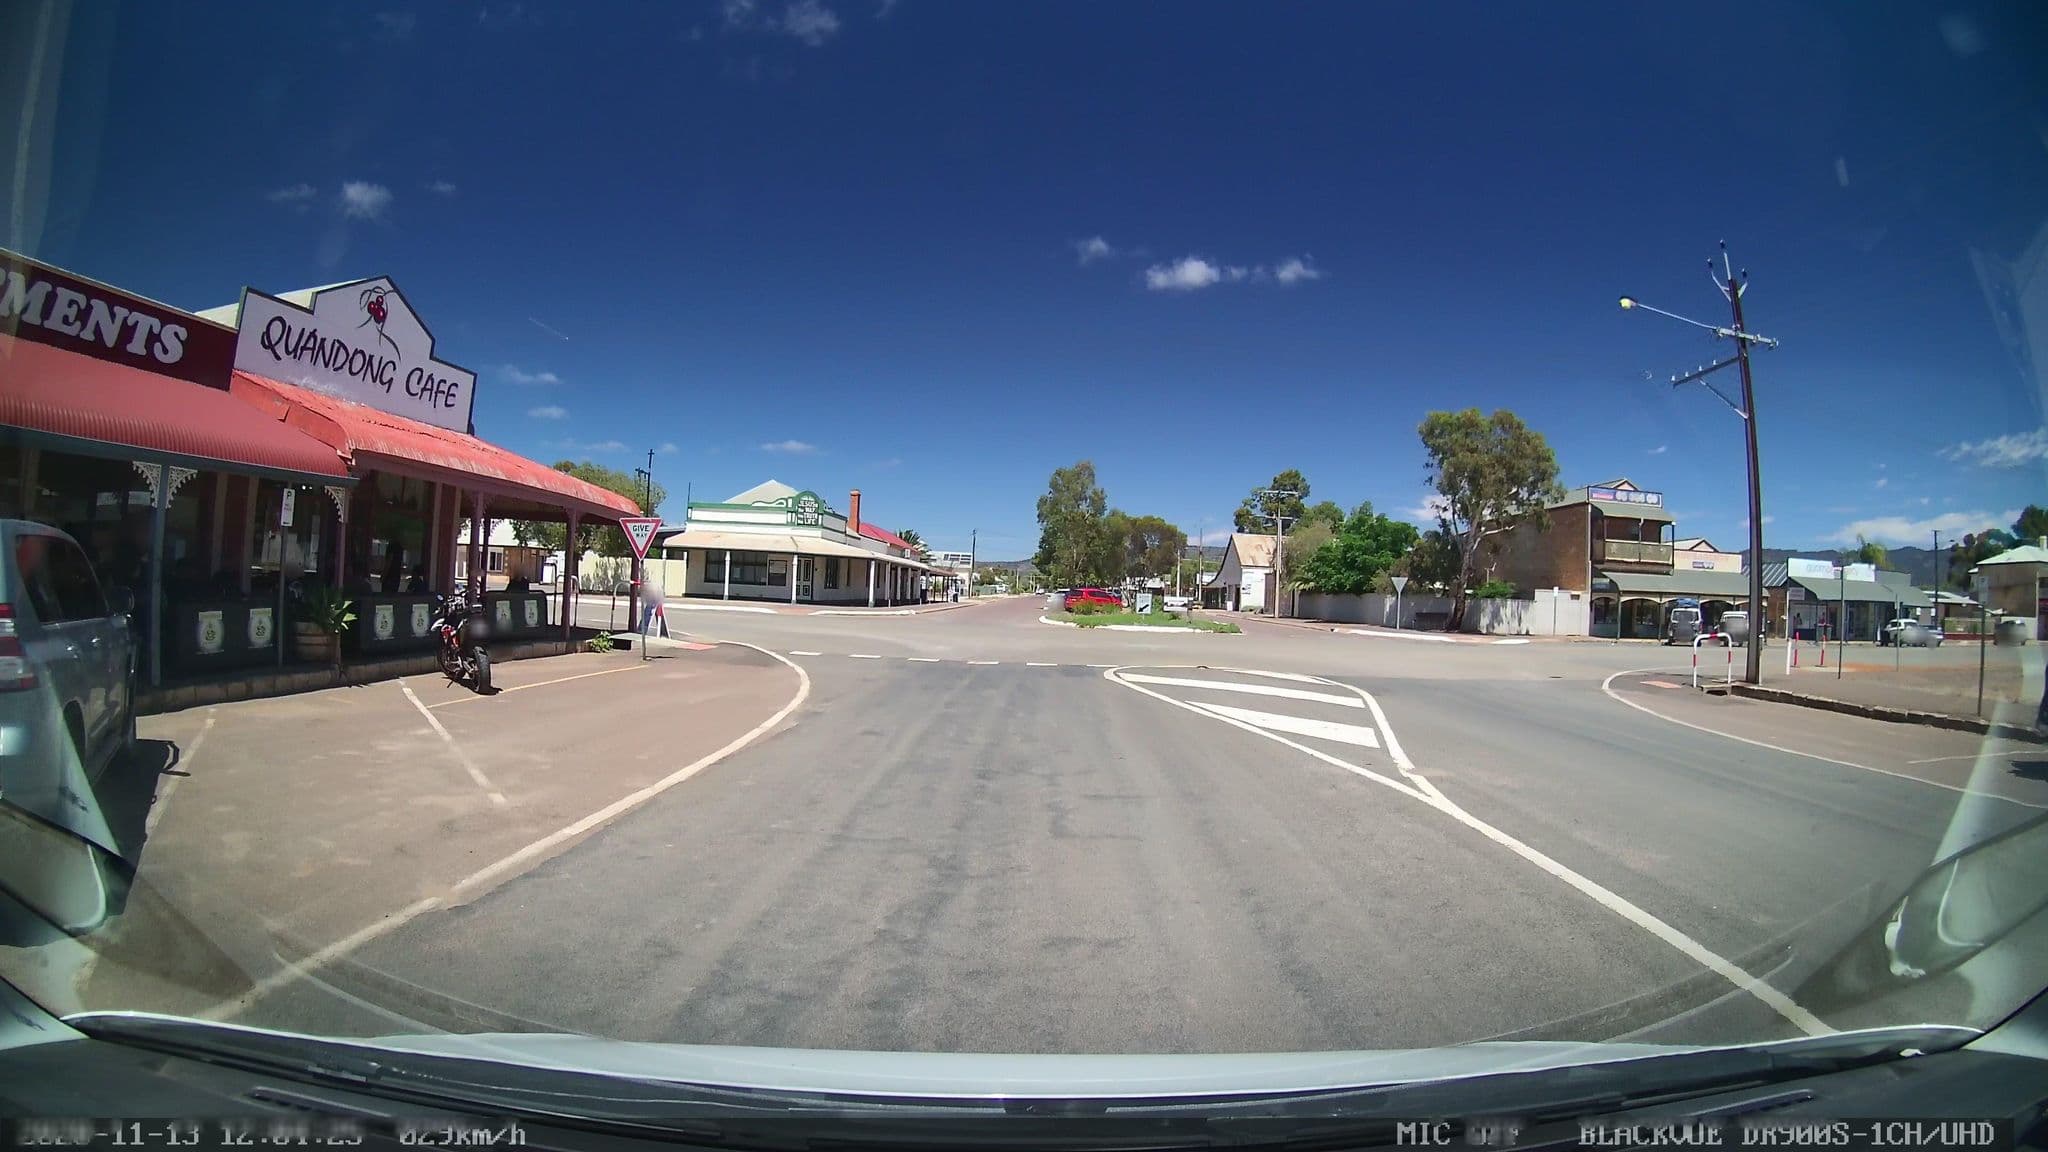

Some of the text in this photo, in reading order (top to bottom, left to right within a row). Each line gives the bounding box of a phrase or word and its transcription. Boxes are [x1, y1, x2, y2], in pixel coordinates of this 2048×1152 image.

[0, 266, 188, 364] MENTS
[261, 316, 459, 408] QUANDONG CAFE
